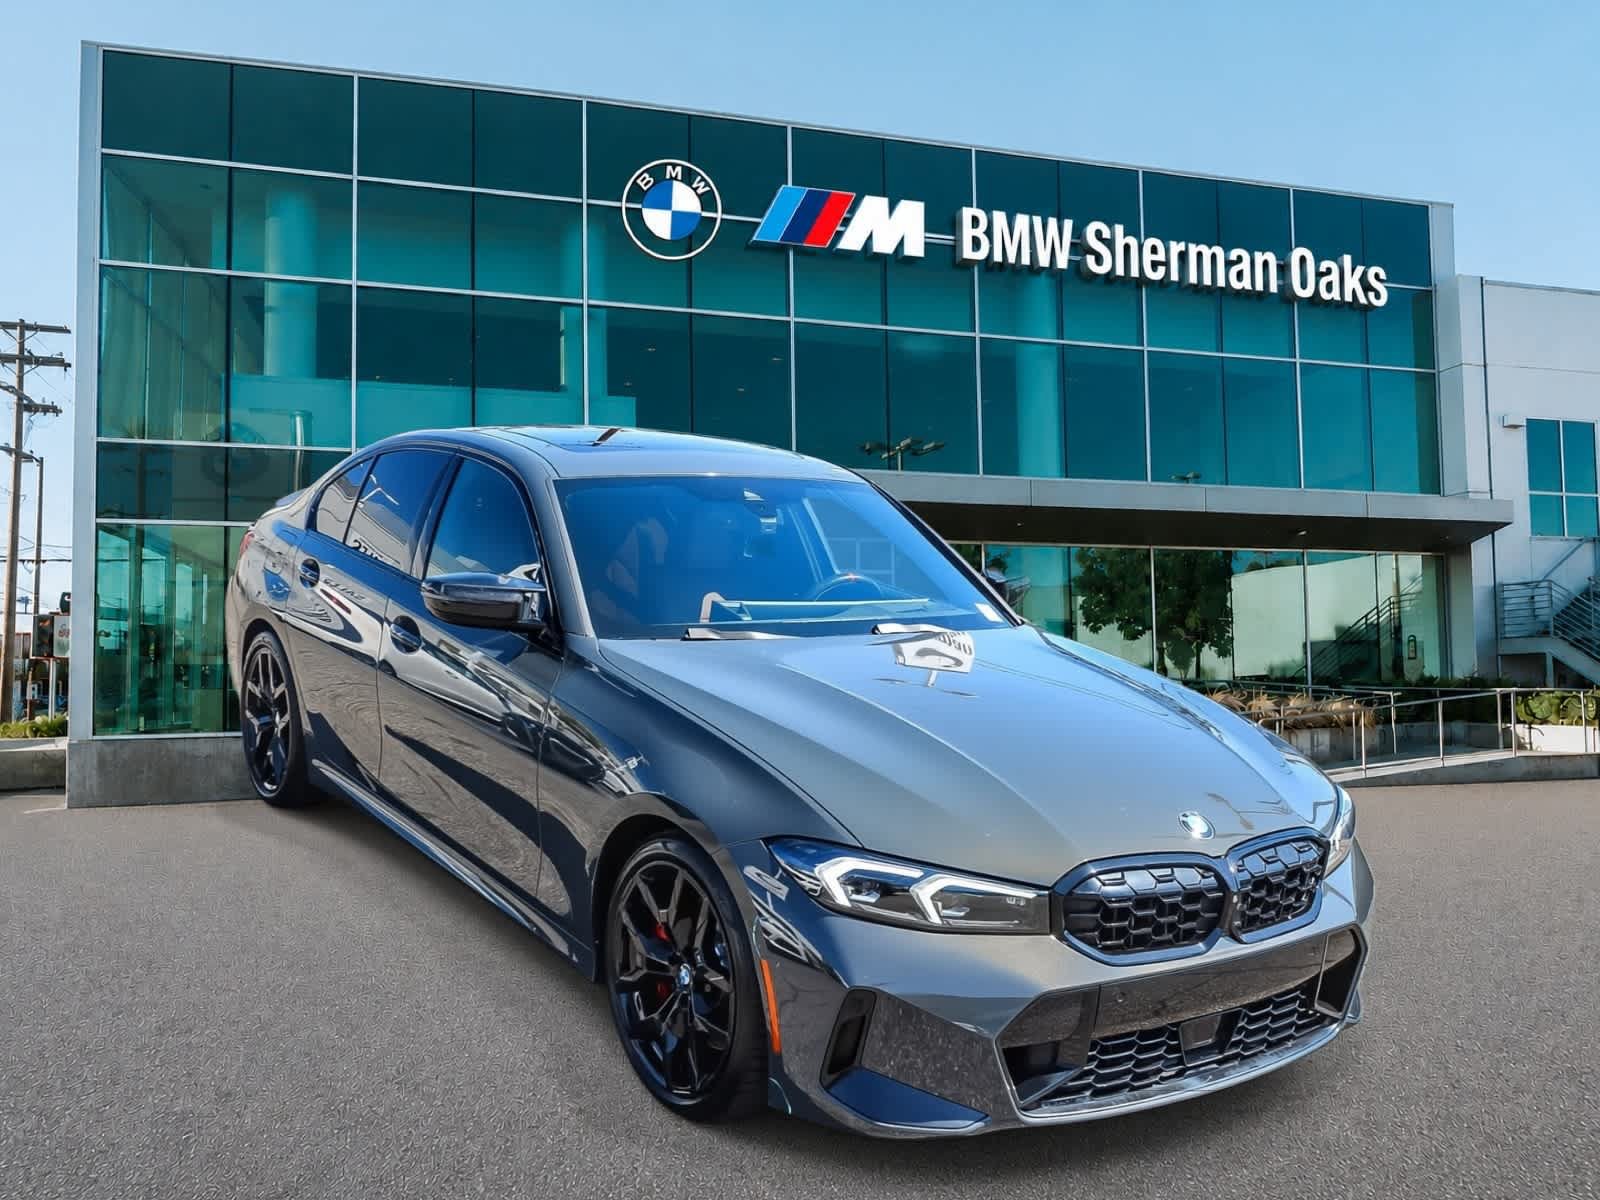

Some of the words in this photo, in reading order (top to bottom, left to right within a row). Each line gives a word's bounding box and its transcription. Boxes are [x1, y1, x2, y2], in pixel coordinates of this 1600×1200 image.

[636, 165, 711, 195] BMW
[835, 194, 925, 258] M
[960, 206, 1073, 270] BMW
[1084, 221, 1279, 293] Sherman
[1290, 247, 1388, 307] Oaks
